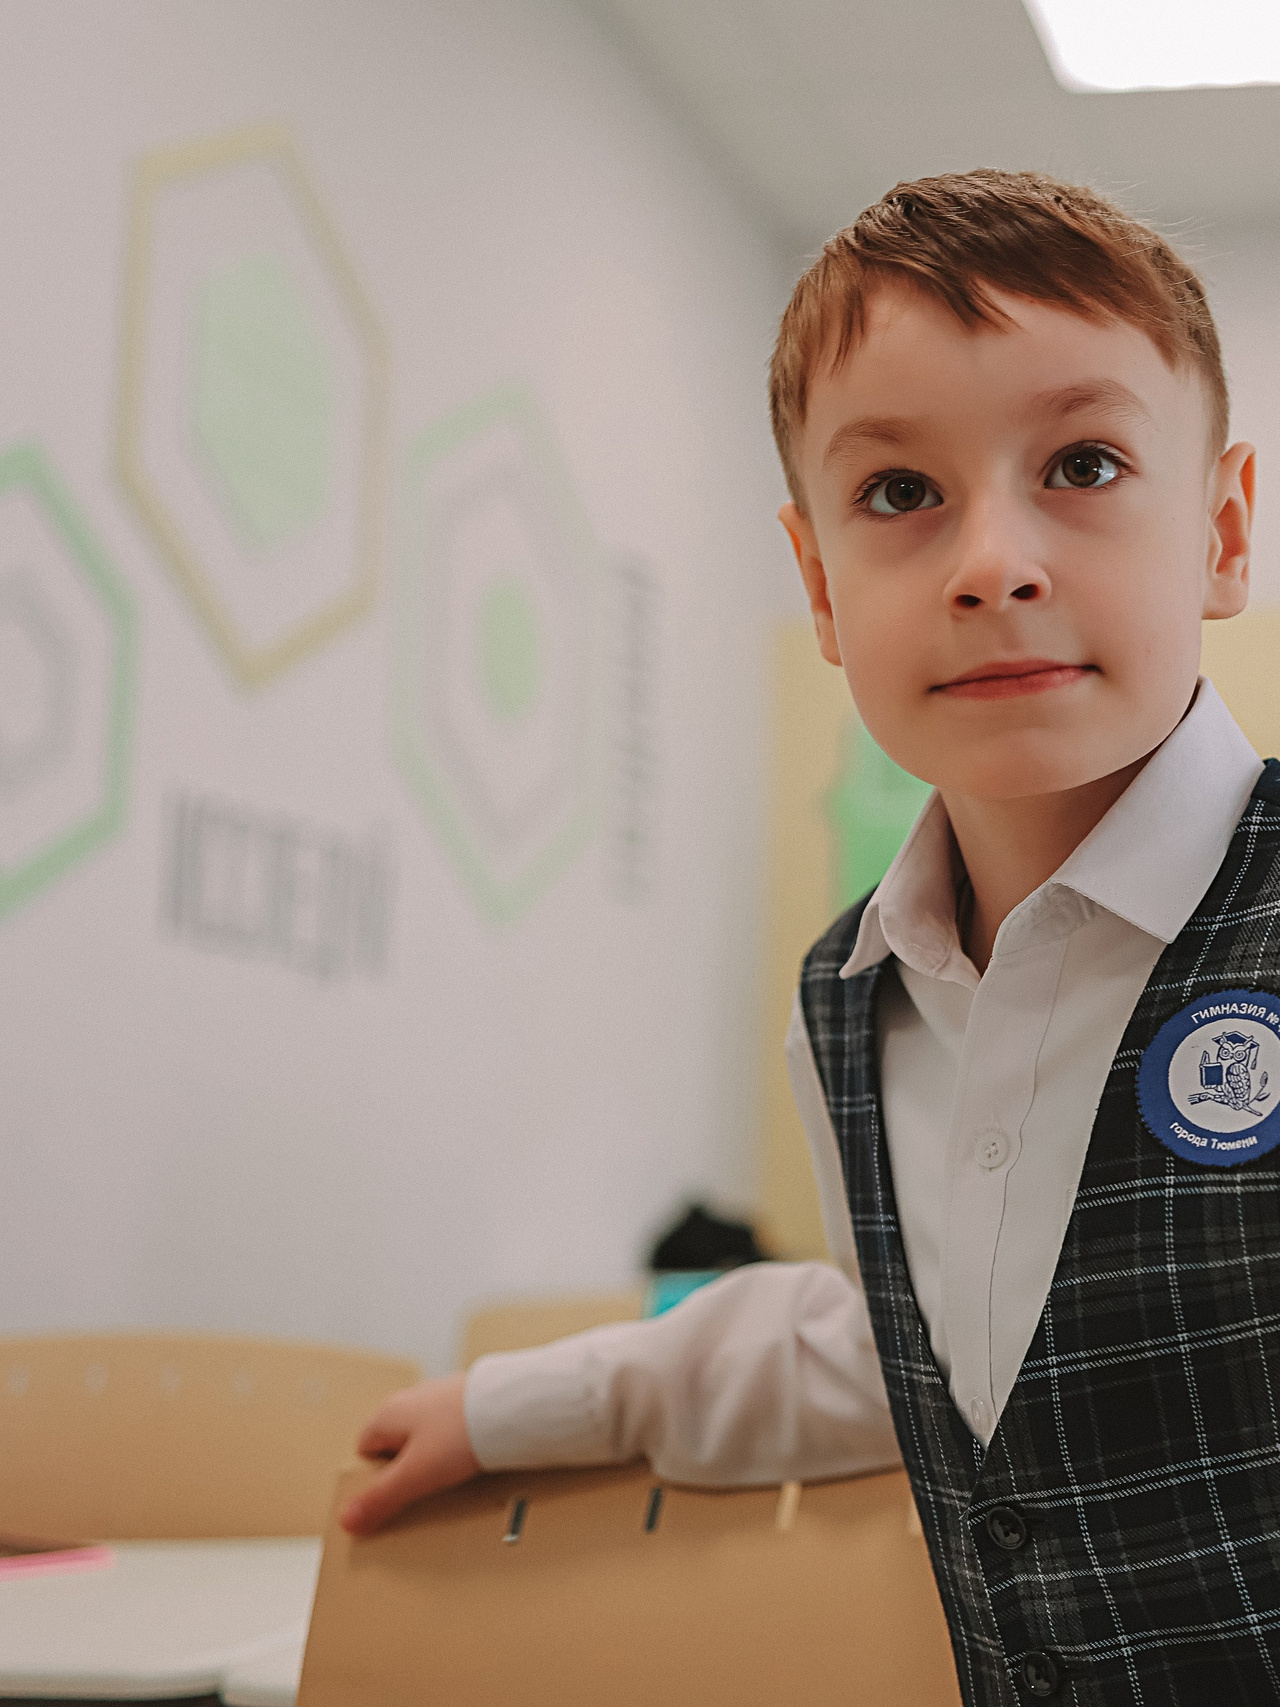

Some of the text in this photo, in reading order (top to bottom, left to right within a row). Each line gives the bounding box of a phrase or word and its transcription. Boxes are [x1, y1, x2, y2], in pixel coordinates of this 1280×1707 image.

[1191, 1003, 1267, 1024] ГИМНАЗИЯ
[1265, 1012, 1280, 1027] №
[1169, 1121, 1259, 1152] города Тюмени
